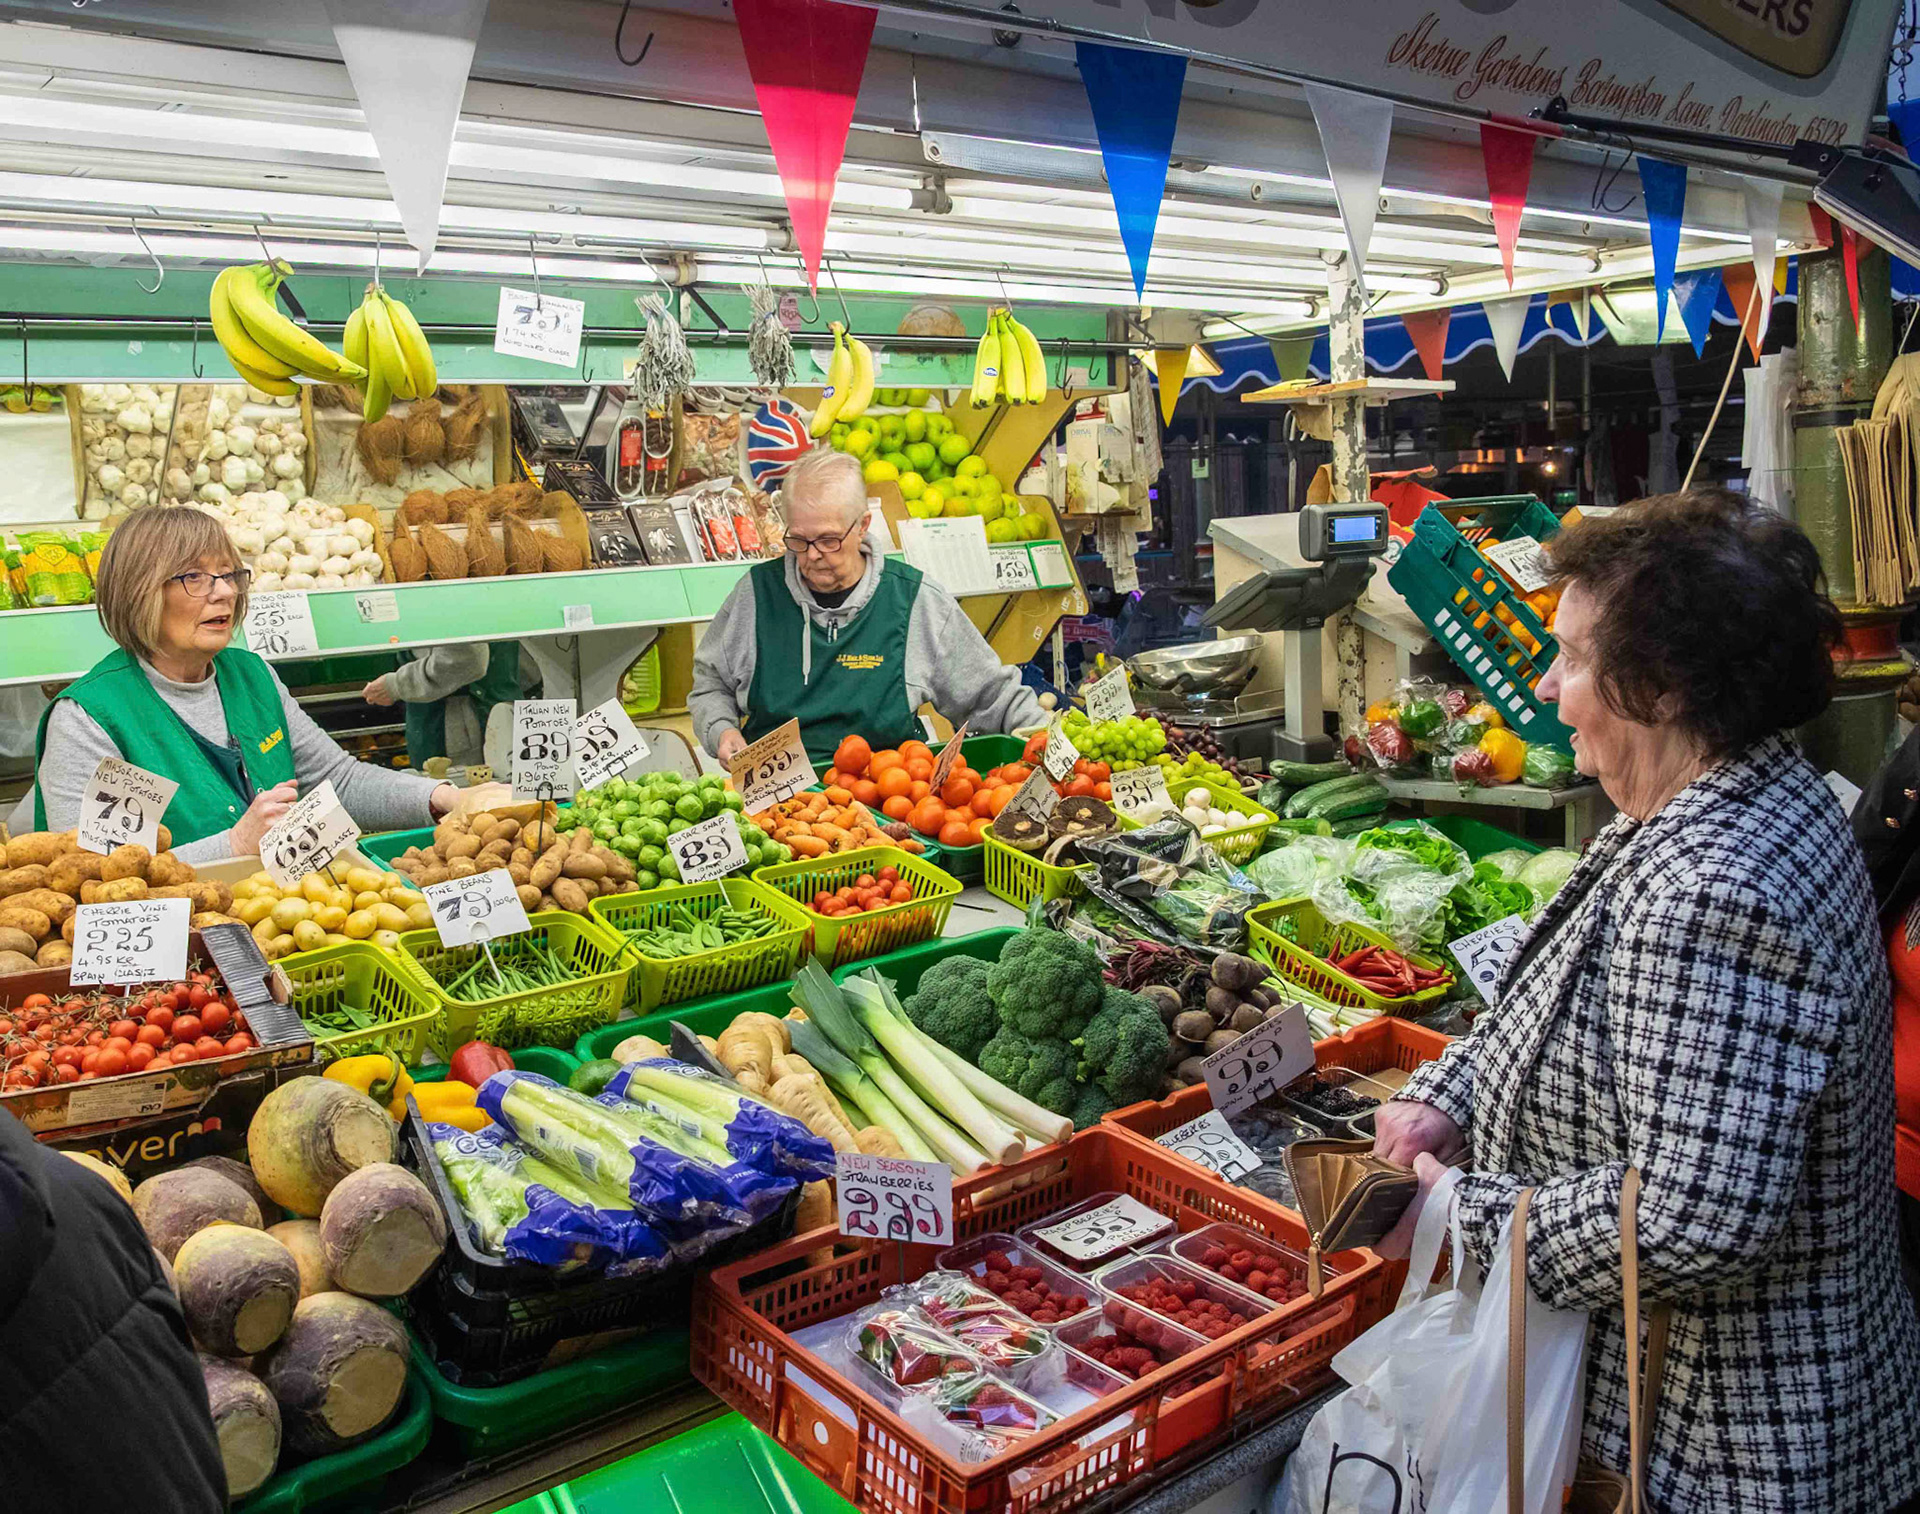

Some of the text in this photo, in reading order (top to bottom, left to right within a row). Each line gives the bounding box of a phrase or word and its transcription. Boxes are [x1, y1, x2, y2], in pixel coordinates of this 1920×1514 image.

[1388, 12, 1471, 76] Skerne
[1456, 35, 1569, 101] Gardens
[253, 610, 285, 627] 55
[252, 634, 290, 655] 40
[519, 703, 570, 716] ITALIAN NEW
[519, 716, 569, 730] POTATOES
[520, 731, 571, 763] 89
[94, 771, 164, 804] NEW POTATOES
[95, 790, 144, 833] 79
[275, 825, 319, 869] 69
[680, 834, 732, 871] 89
[426, 873, 493, 900] FINE BEANS
[81, 903, 169, 917] CHERRIE VINE
[87, 914, 161, 928] TOMATOES
[436, 891, 492, 922] 79
[1453, 921, 1516, 952] CHERRIES
[73, 971, 105, 982] SPAIN
[1202, 1016, 1282, 1069] BLACKBERRIES
[1218, 1039, 1284, 1096] 99
[841, 1155, 871, 1170] NEW
[841, 1169, 935, 1192] STRAWBERRIES
[1037, 1203, 1120, 1236] RASPBERRIES
[1061, 1215, 1137, 1246] 99
